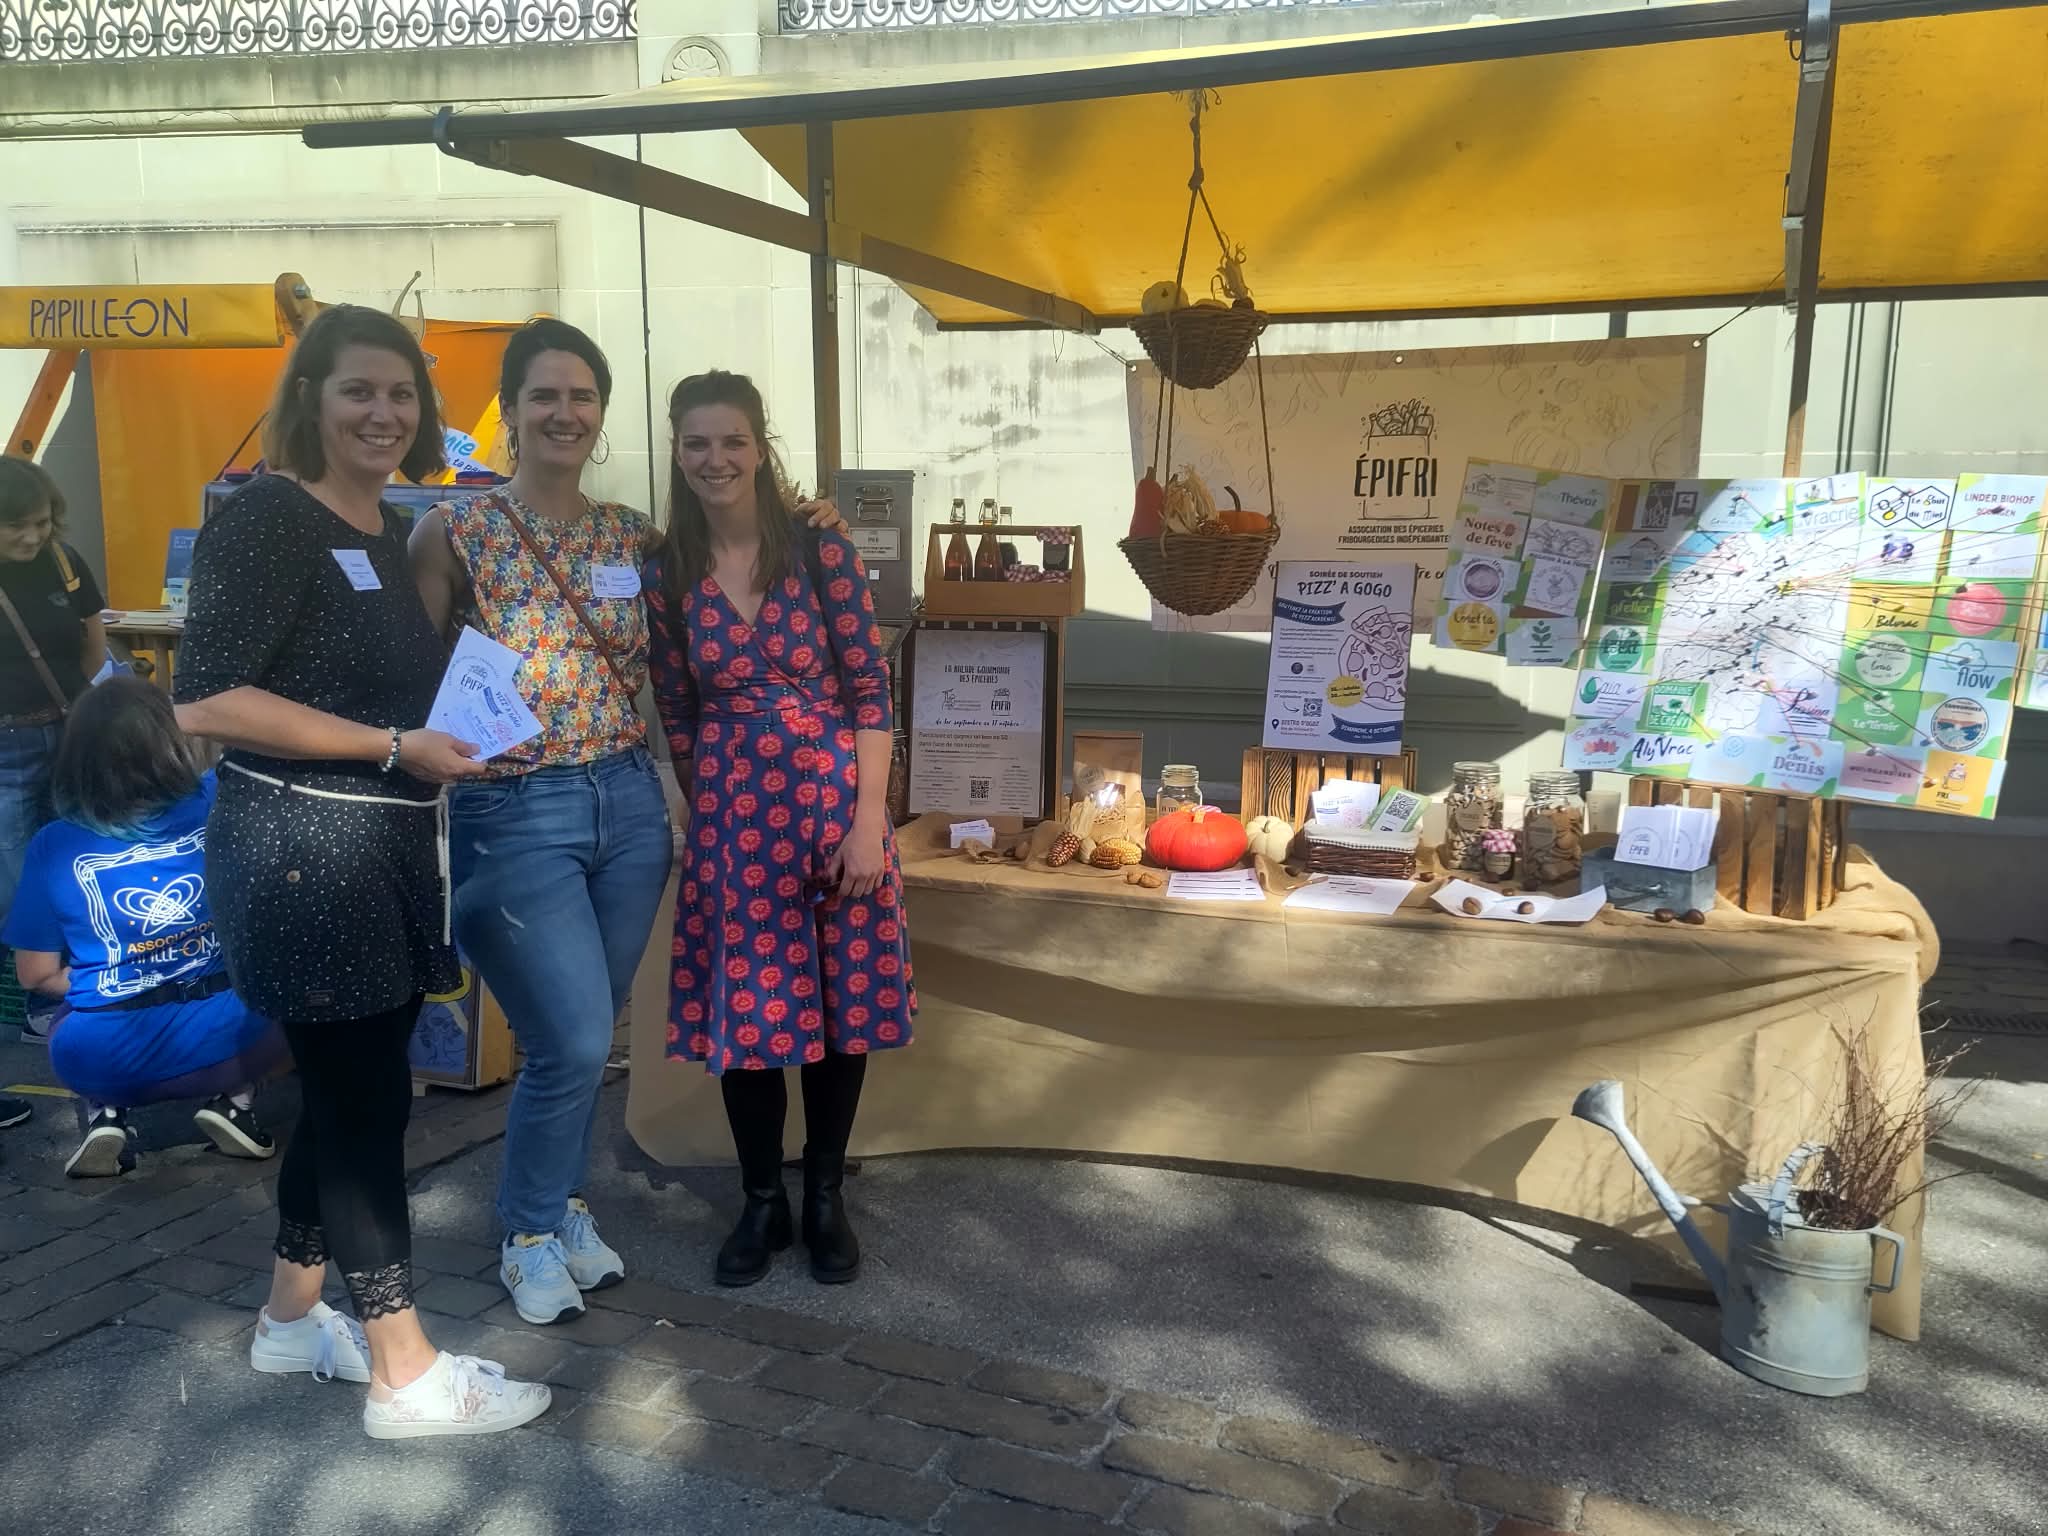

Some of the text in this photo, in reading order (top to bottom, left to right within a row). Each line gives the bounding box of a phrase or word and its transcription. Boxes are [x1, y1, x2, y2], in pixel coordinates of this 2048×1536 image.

[1354, 453, 1438, 498] ÉPIFRI
[1964, 493, 2036, 505] LINDER BIOHOF
[1348, 523, 1445, 534] ASSOCIATION DES ÉPICERIES
[1464, 517, 1501, 533] Notes
[1338, 534, 1450, 544] FRIBOURGEOISES INDÉPENDANTE
[1466, 532, 1513, 550] de fève
[1309, 569, 1336, 578] SOIRÉE
[1349, 571, 1384, 579] SOUTIEN
[1340, 581, 1349, 594] A
[1353, 582, 1392, 598] GOGO
[1957, 667, 1994, 690] flow
[1774, 756, 1825, 776] Denis
